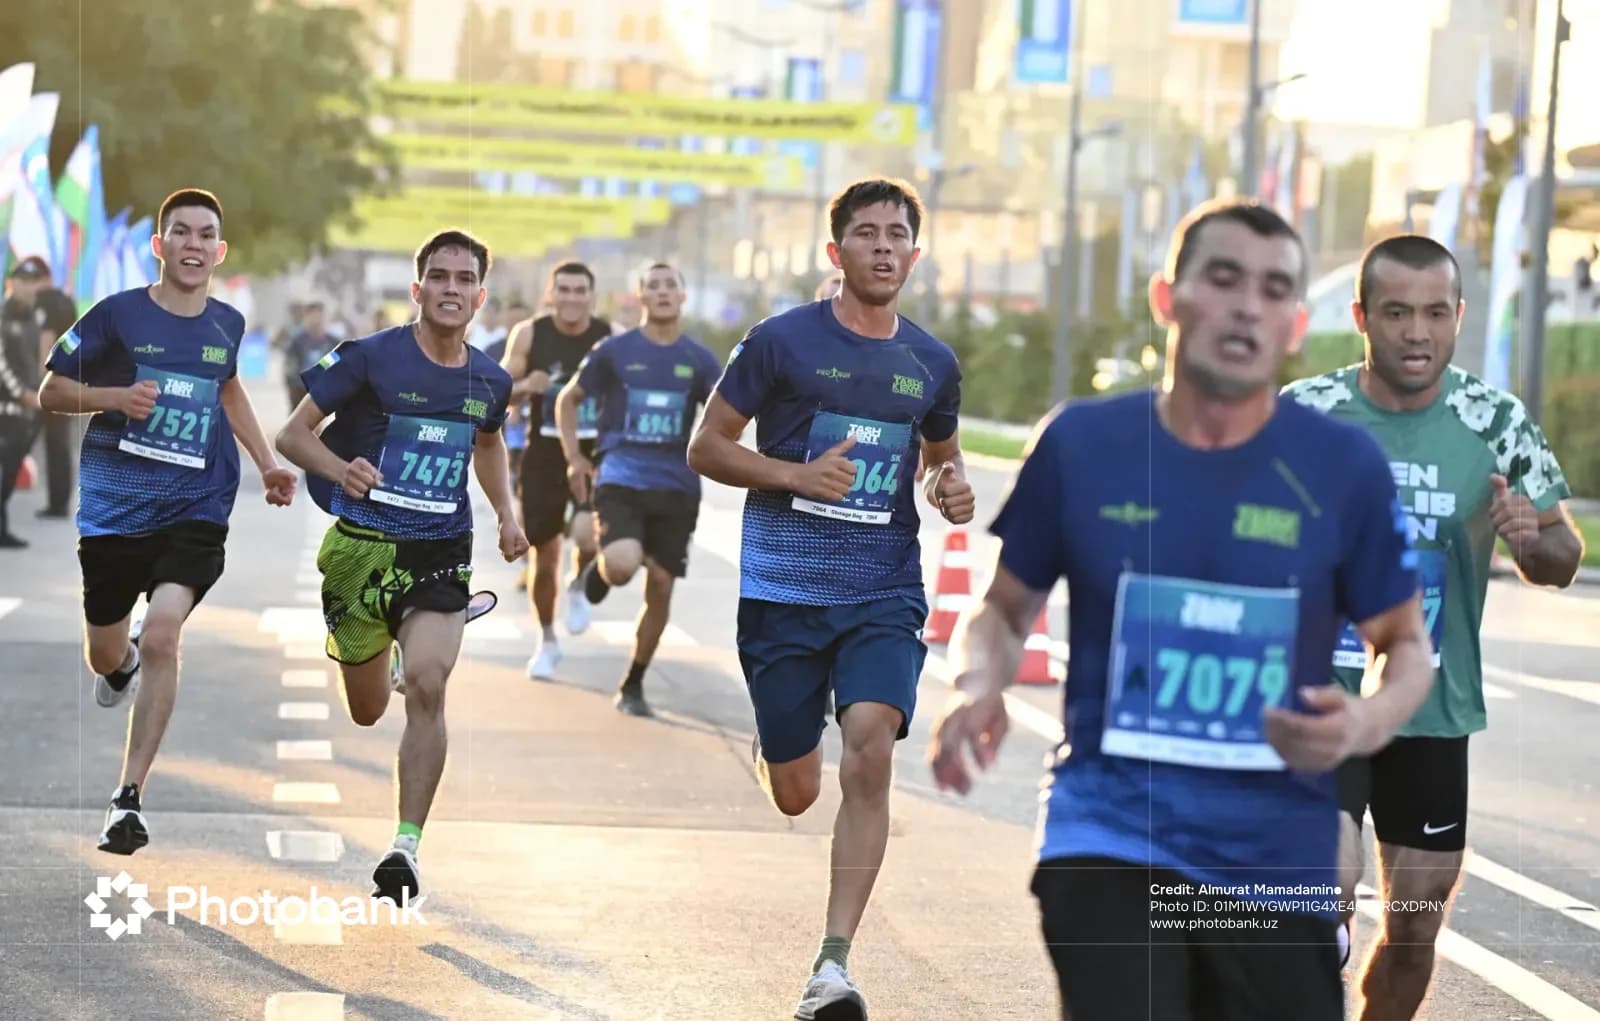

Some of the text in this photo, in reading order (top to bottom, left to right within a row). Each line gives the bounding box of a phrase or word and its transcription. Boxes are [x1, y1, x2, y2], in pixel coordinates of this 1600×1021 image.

[147, 405, 211, 444] 7521
[639, 411, 682, 435] 6941
[849, 423, 882, 438] TASH
[400, 451, 464, 489] 7473
[848, 458, 899, 496] 064
[1156, 648, 1289, 718] 7079
